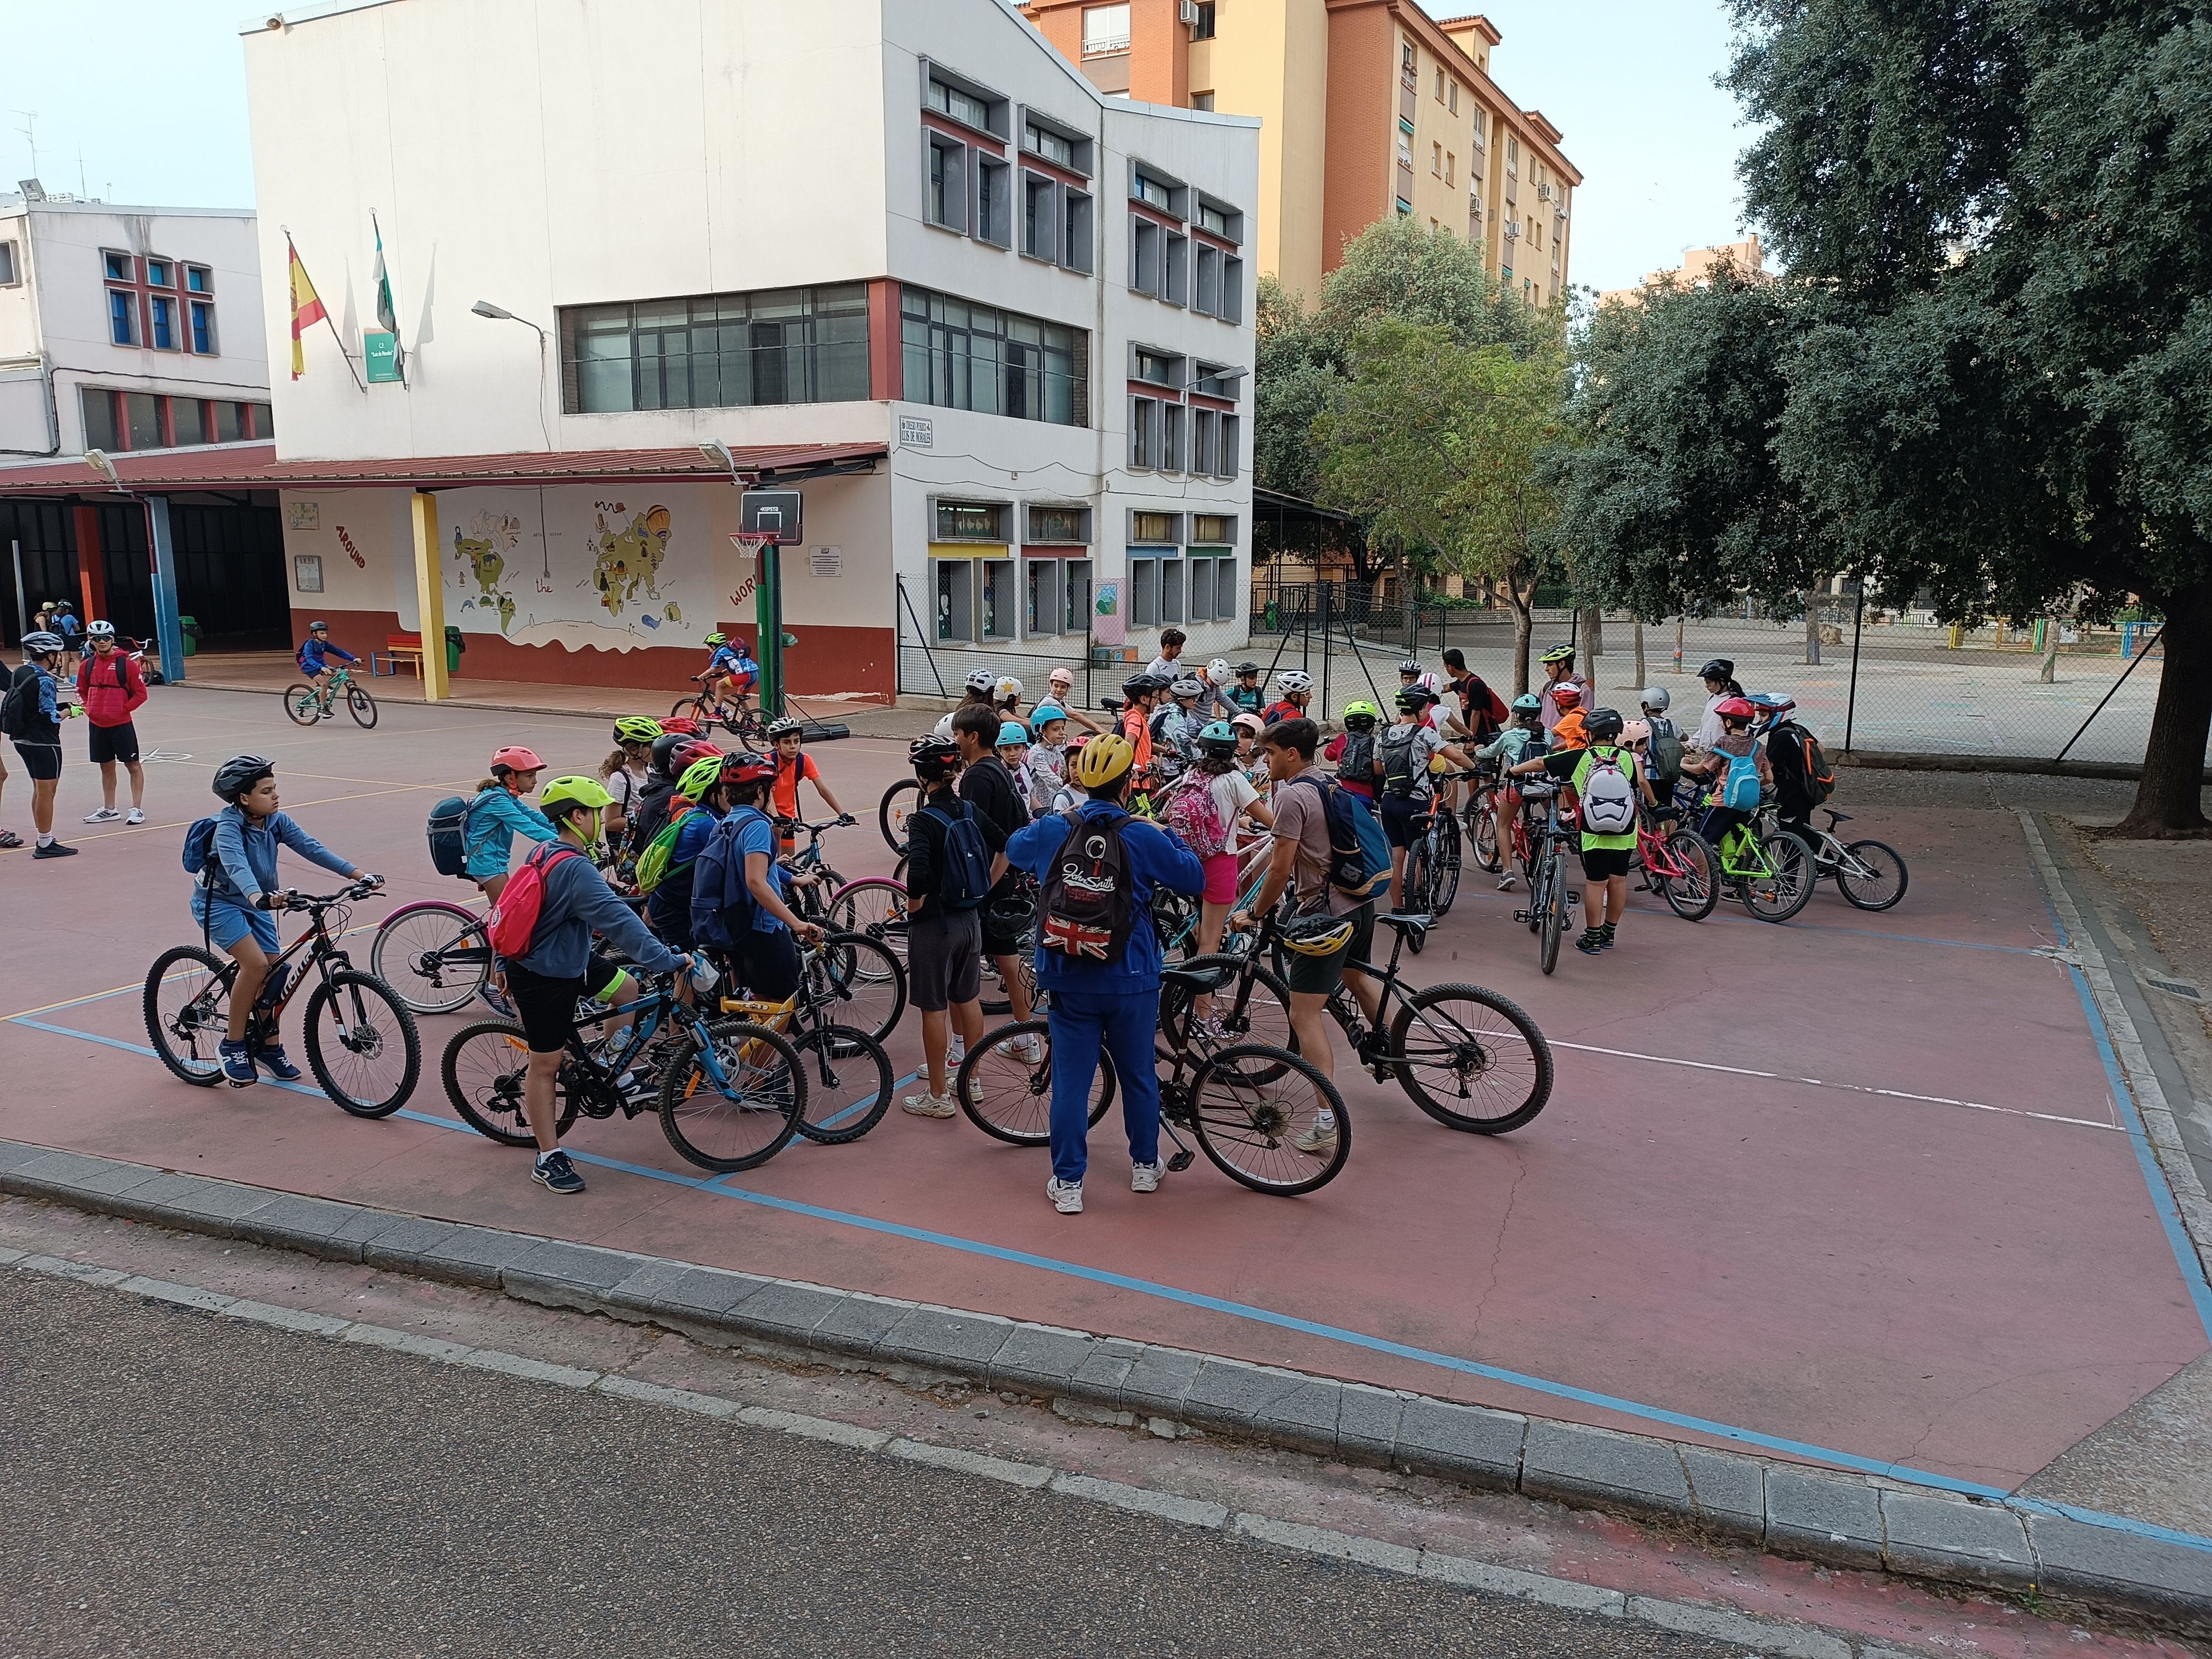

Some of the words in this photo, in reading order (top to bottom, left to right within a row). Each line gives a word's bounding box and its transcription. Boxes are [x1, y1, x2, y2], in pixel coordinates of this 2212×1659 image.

[910, 431, 915, 441] DE
[916, 432, 930, 444] MORALES
[336, 526, 365, 568] AROUND
[536, 578, 553, 593] the
[1062, 863, 1088, 885] John
